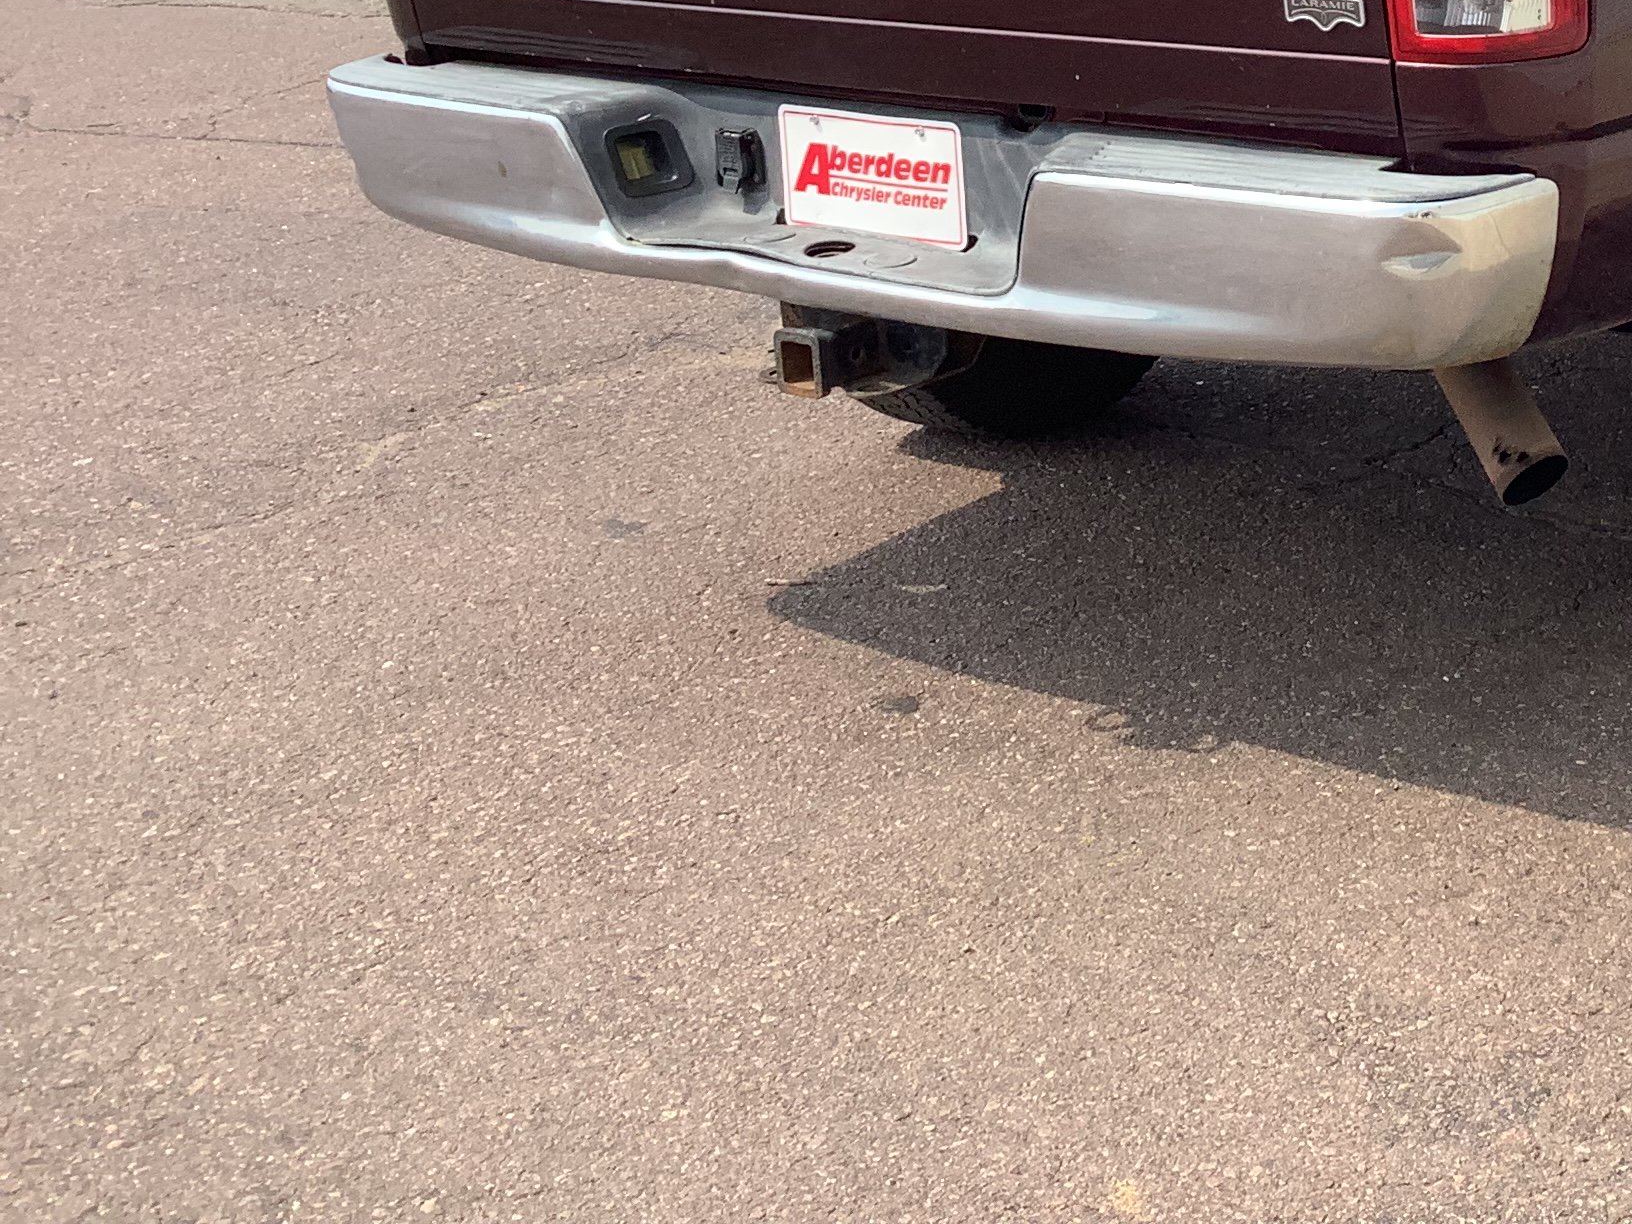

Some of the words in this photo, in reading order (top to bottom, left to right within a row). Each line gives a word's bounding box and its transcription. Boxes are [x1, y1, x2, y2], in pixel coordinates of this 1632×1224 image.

[794, 142, 951, 195] Aberdeen
[831, 181, 891, 203] Chrysler
[893, 191, 947, 210] Center
